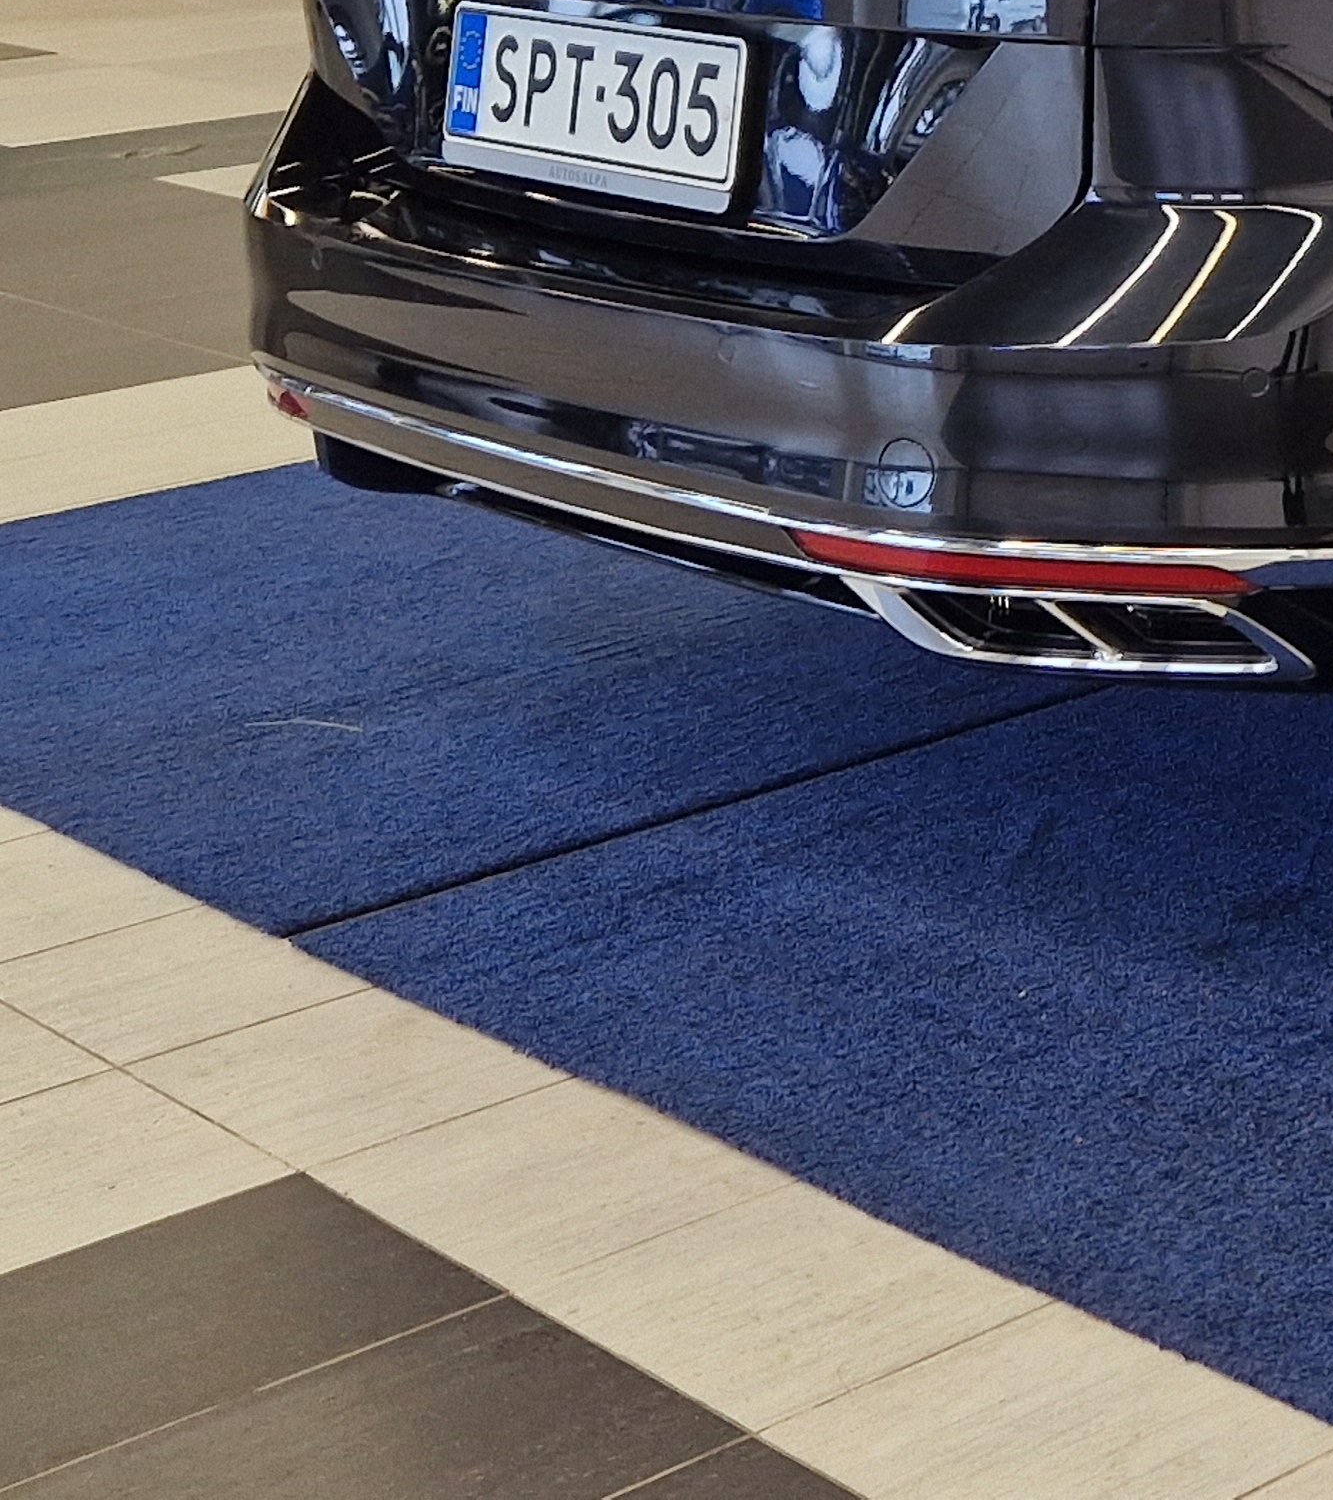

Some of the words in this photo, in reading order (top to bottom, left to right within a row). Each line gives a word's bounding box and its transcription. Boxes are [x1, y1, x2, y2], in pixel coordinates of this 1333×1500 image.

[453, 84, 478, 115] FIN
[491, 34, 721, 157] SPT-305
[548, 165, 608, 189] AUTOSALPA
